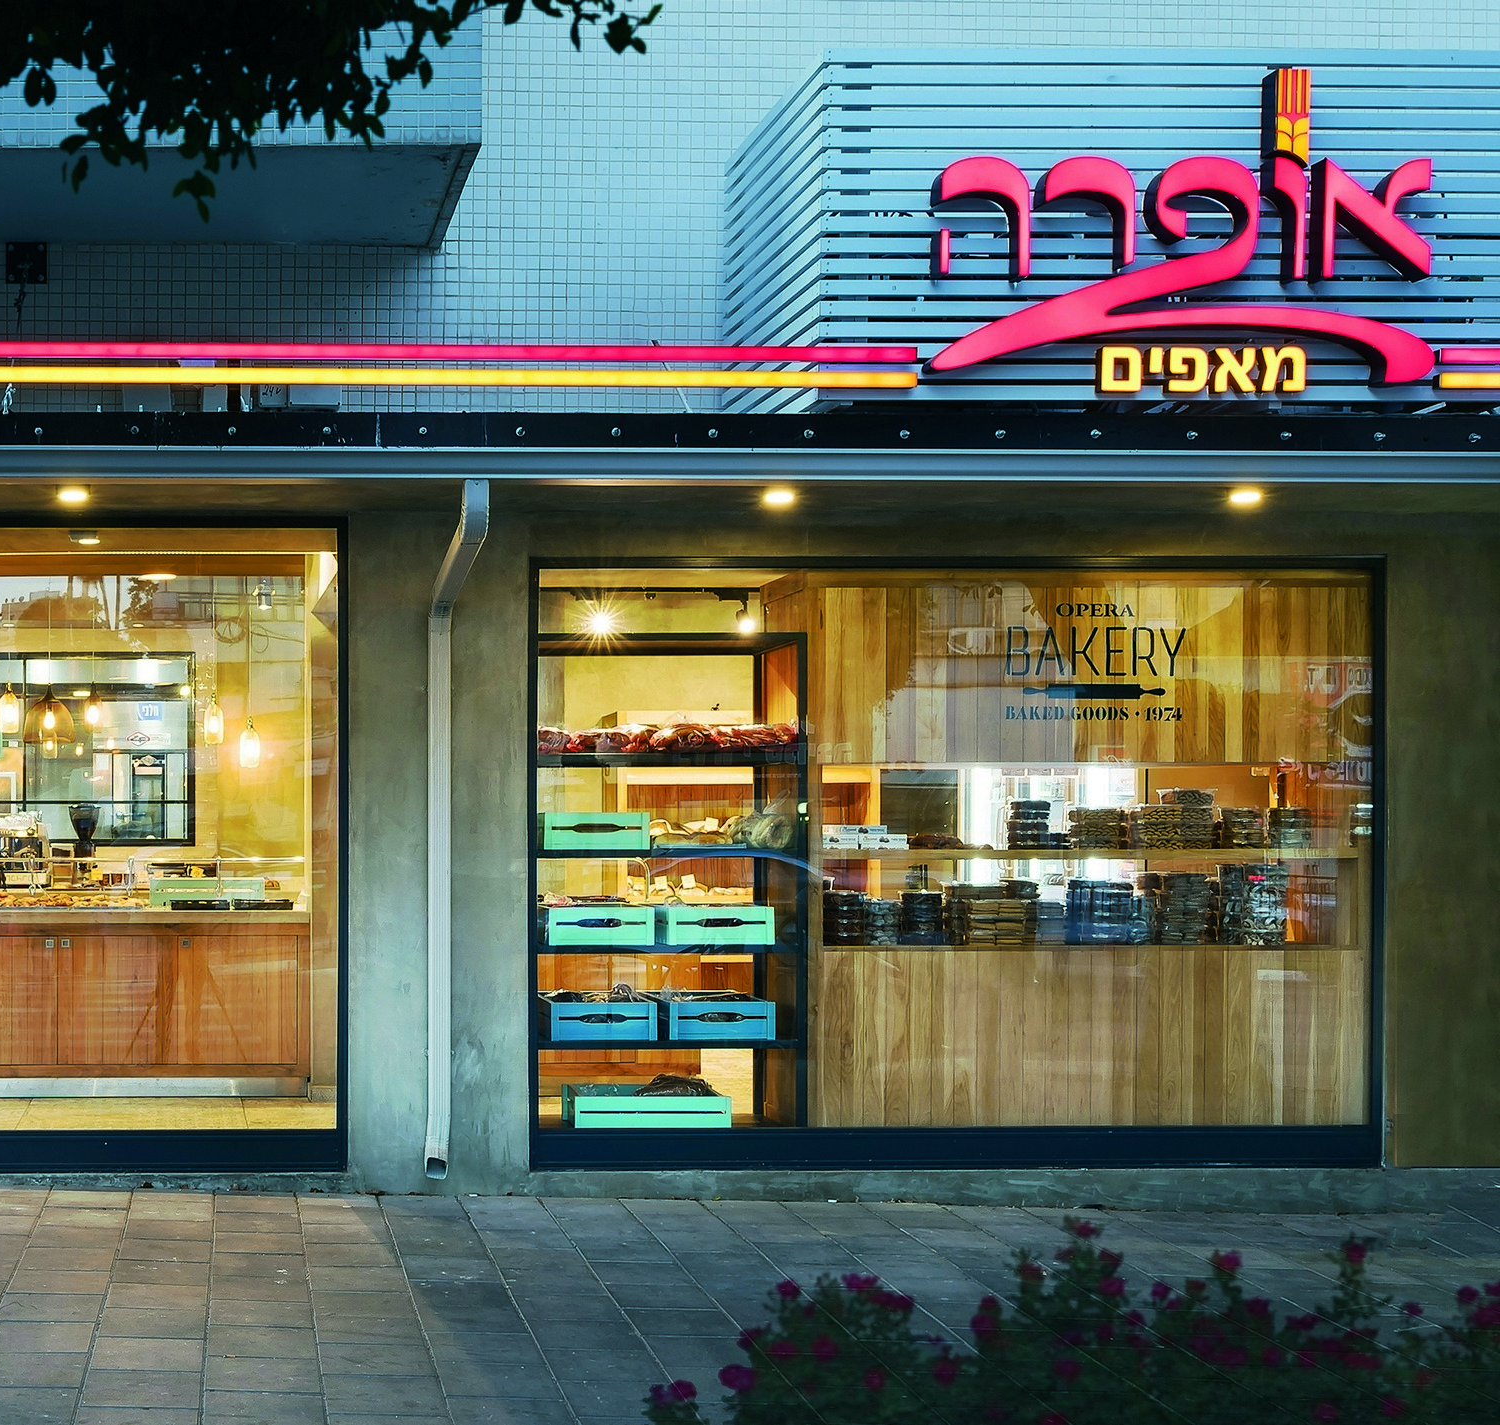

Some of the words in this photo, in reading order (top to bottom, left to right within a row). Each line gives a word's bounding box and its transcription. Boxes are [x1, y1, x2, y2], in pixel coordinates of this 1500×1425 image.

[1095, 345, 1307, 394] מאפים
[1055, 602, 1135, 617] OPERA
[1005, 625, 1187, 677] BAKERY
[1004, 706, 1065, 721] BAKED
[1070, 706, 1129, 721] GOODS
[1144, 706, 1183, 721] 1974
